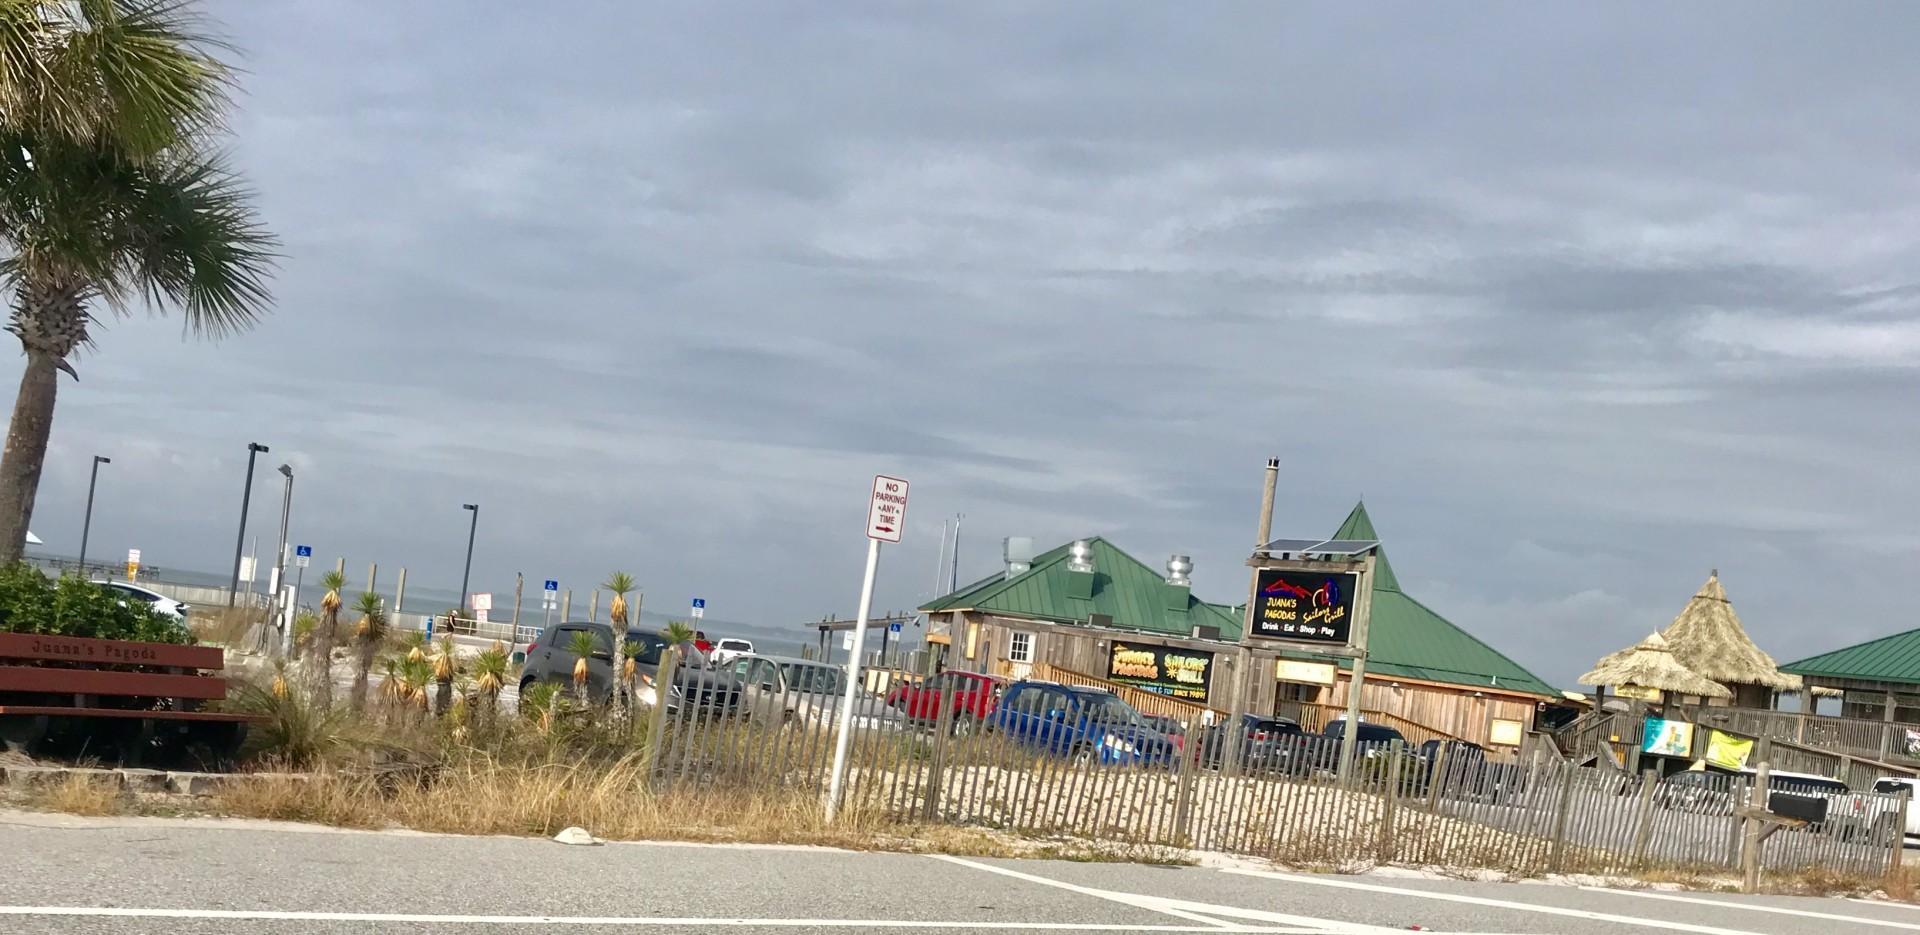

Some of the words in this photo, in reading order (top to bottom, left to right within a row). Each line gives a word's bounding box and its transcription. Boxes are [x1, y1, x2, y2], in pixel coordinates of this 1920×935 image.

[885, 482, 899, 492] NO
[875, 491, 906, 505] PARKING
[881, 504, 896, 514] ANY
[879, 514, 896, 525] TIME
[1266, 597, 1297, 608] JUANA'S
[1264, 609, 1297, 621] PAGODAS
[1323, 605, 1345, 624] Grill
[1261, 621, 1279, 631] Drink
[1284, 623, 1295, 632] Eat
[1300, 624, 1316, 635] Shop
[1321, 626, 1335, 637] Play
[32, 640, 95, 656] Juana's
[104, 645, 157, 660] Pagoda
